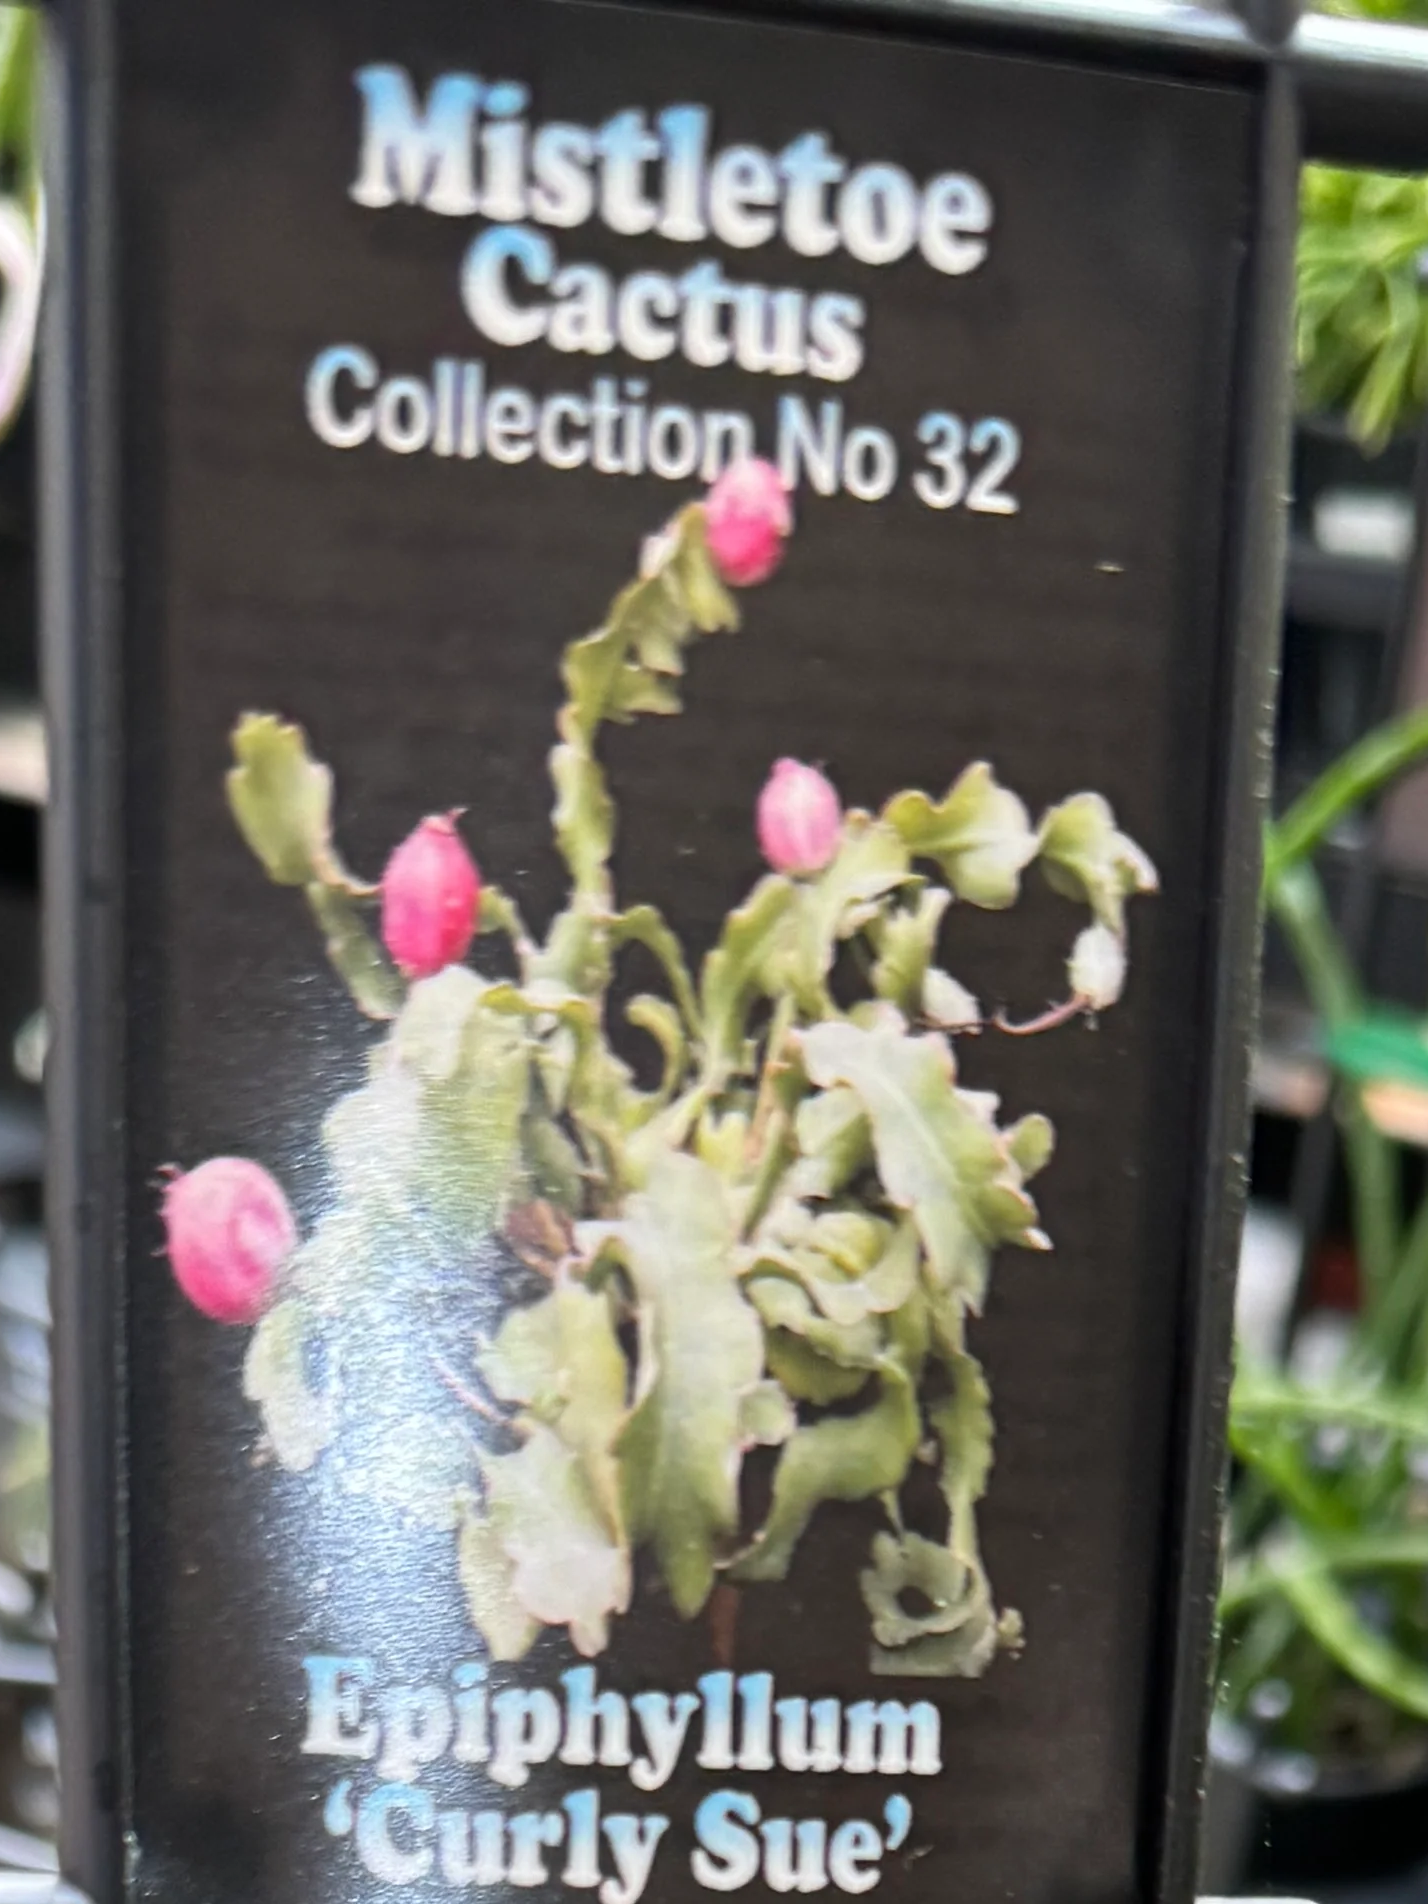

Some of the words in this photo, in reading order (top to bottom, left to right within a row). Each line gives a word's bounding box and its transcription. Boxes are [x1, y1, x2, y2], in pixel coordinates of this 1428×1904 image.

[350, 64, 993, 275] Mistletoe
[461, 224, 865, 382] Cactus
[305, 345, 755, 481] Collection
[777, 394, 898, 502] No
[913, 411, 1021, 515] 32
[300, 1656, 942, 1790] Epiphyllum
[691, 1790, 913, 1894] Sue’
